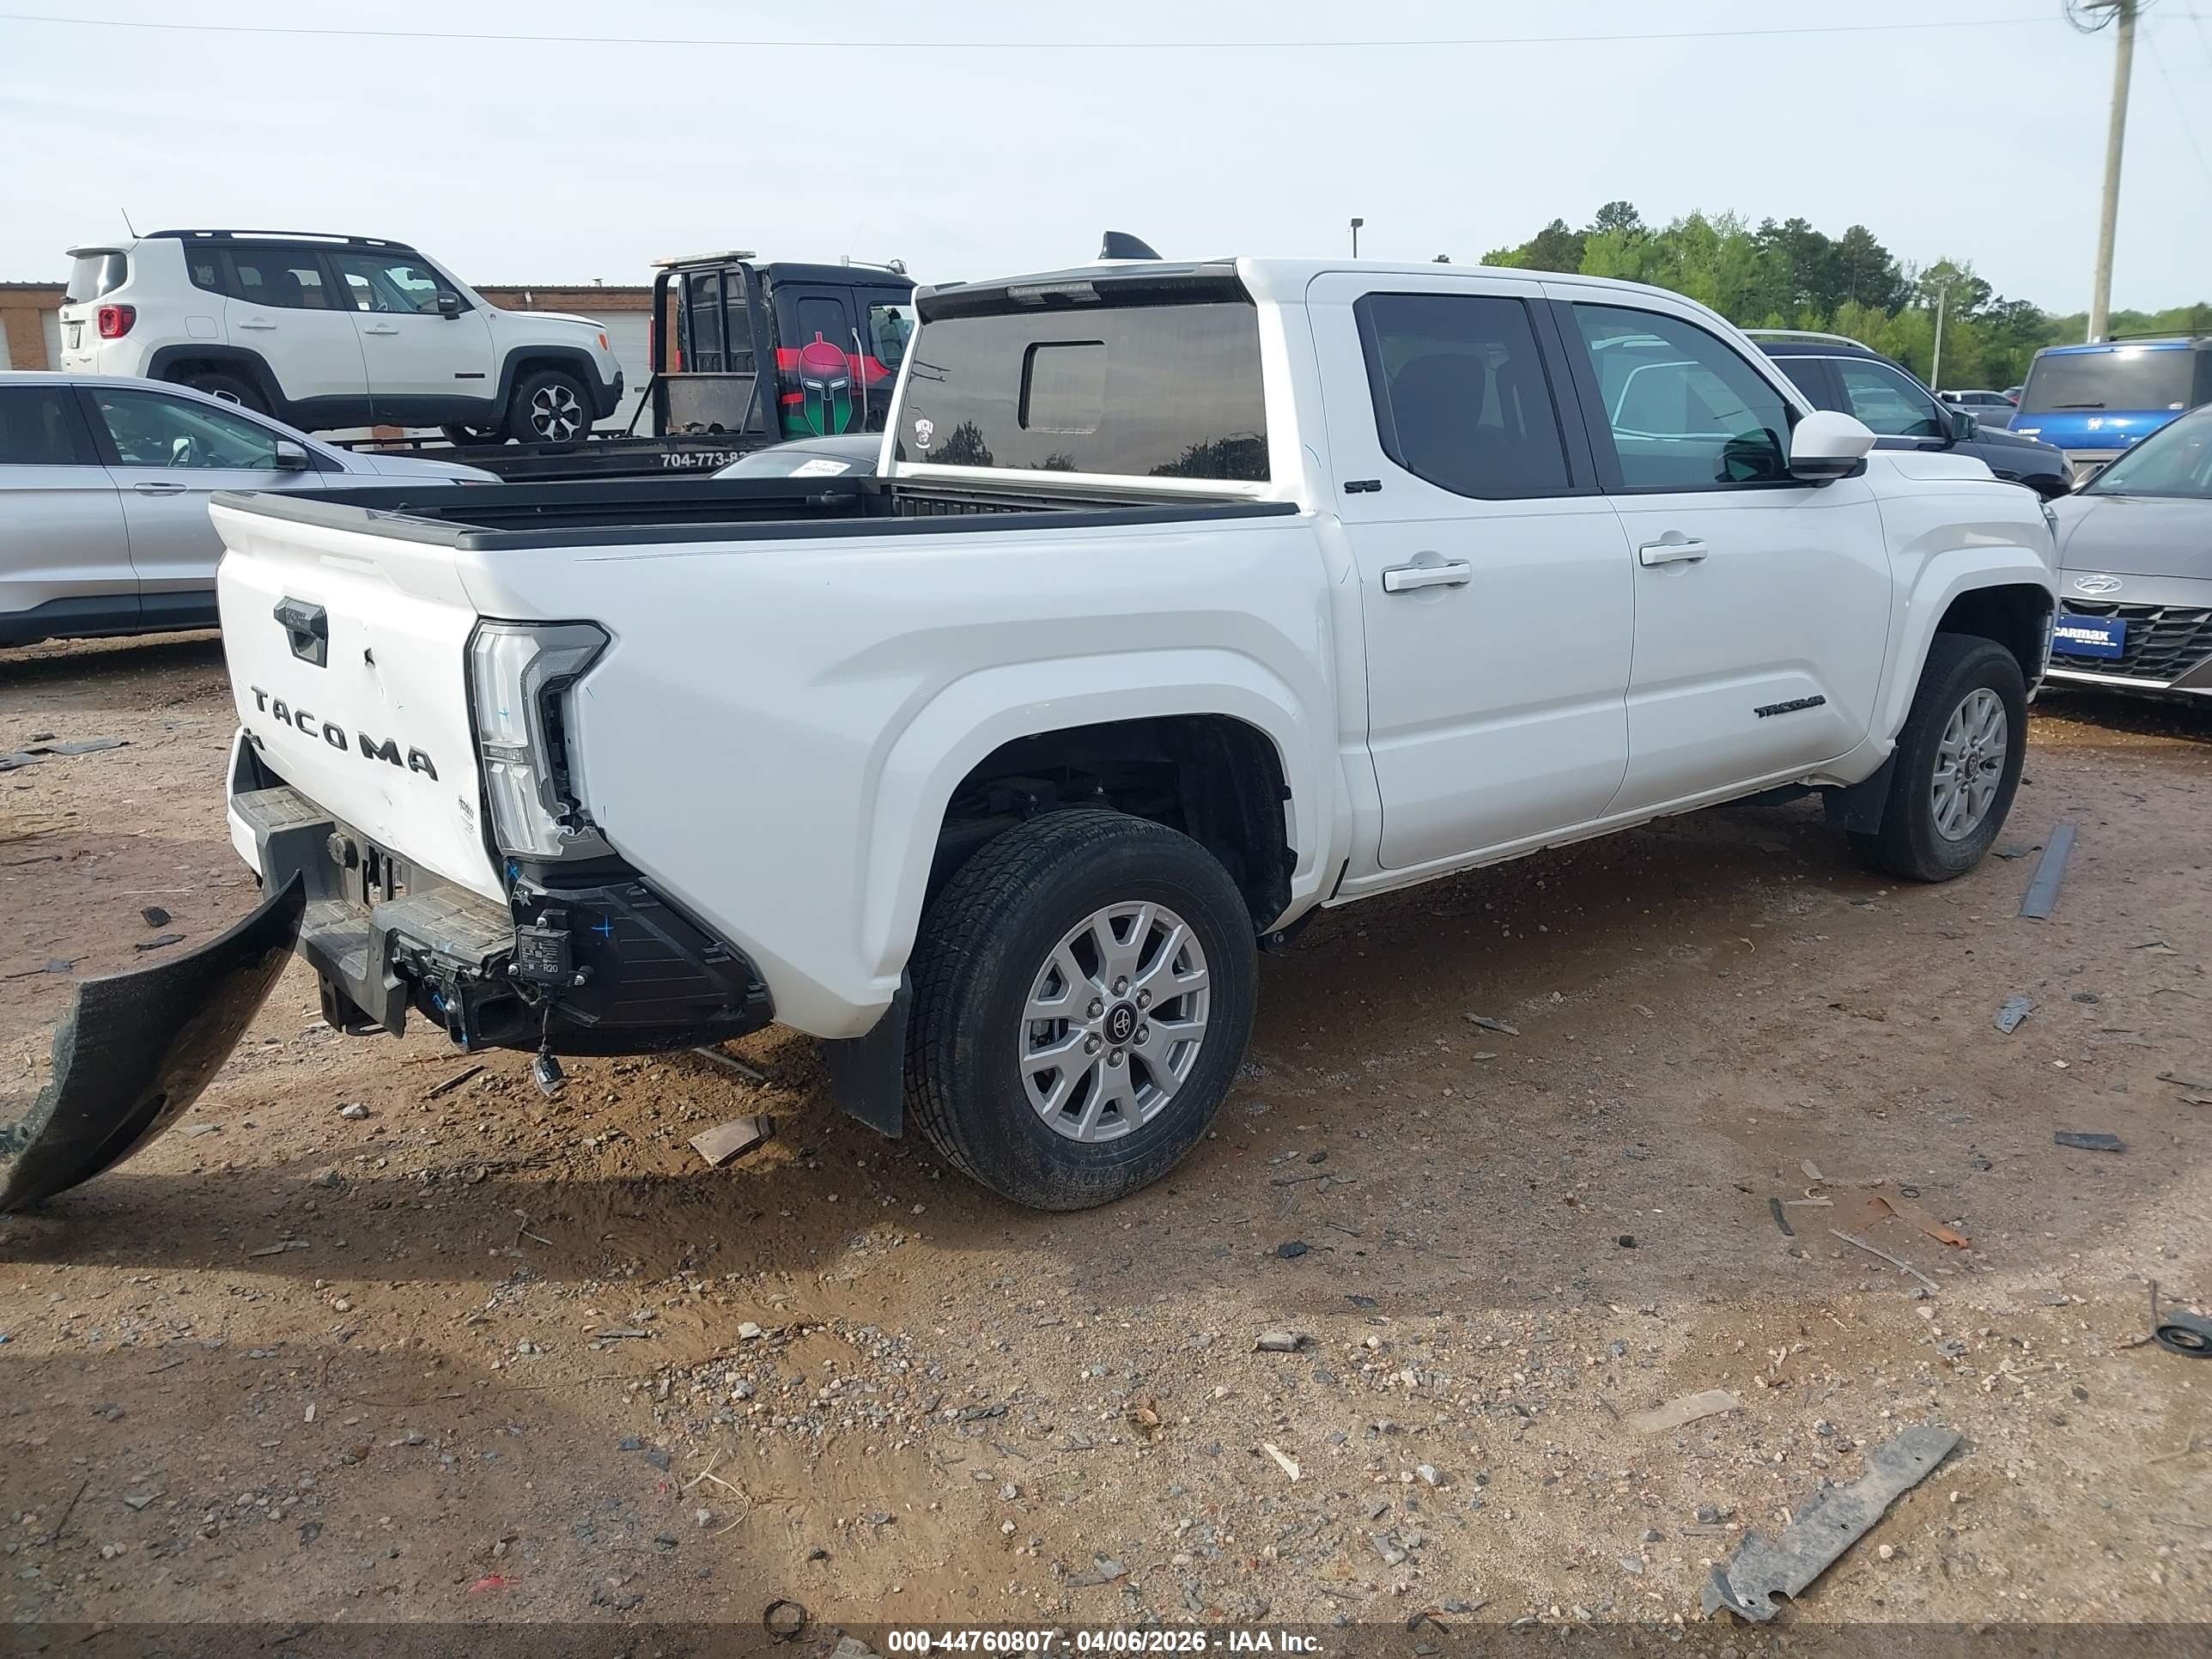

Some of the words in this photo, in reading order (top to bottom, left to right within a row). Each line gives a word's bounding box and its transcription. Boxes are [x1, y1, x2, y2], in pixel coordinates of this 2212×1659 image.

[1753, 694, 1826, 718] TACOMA
[250, 684, 439, 781] TACOMA
[543, 963, 558, 973] R20
